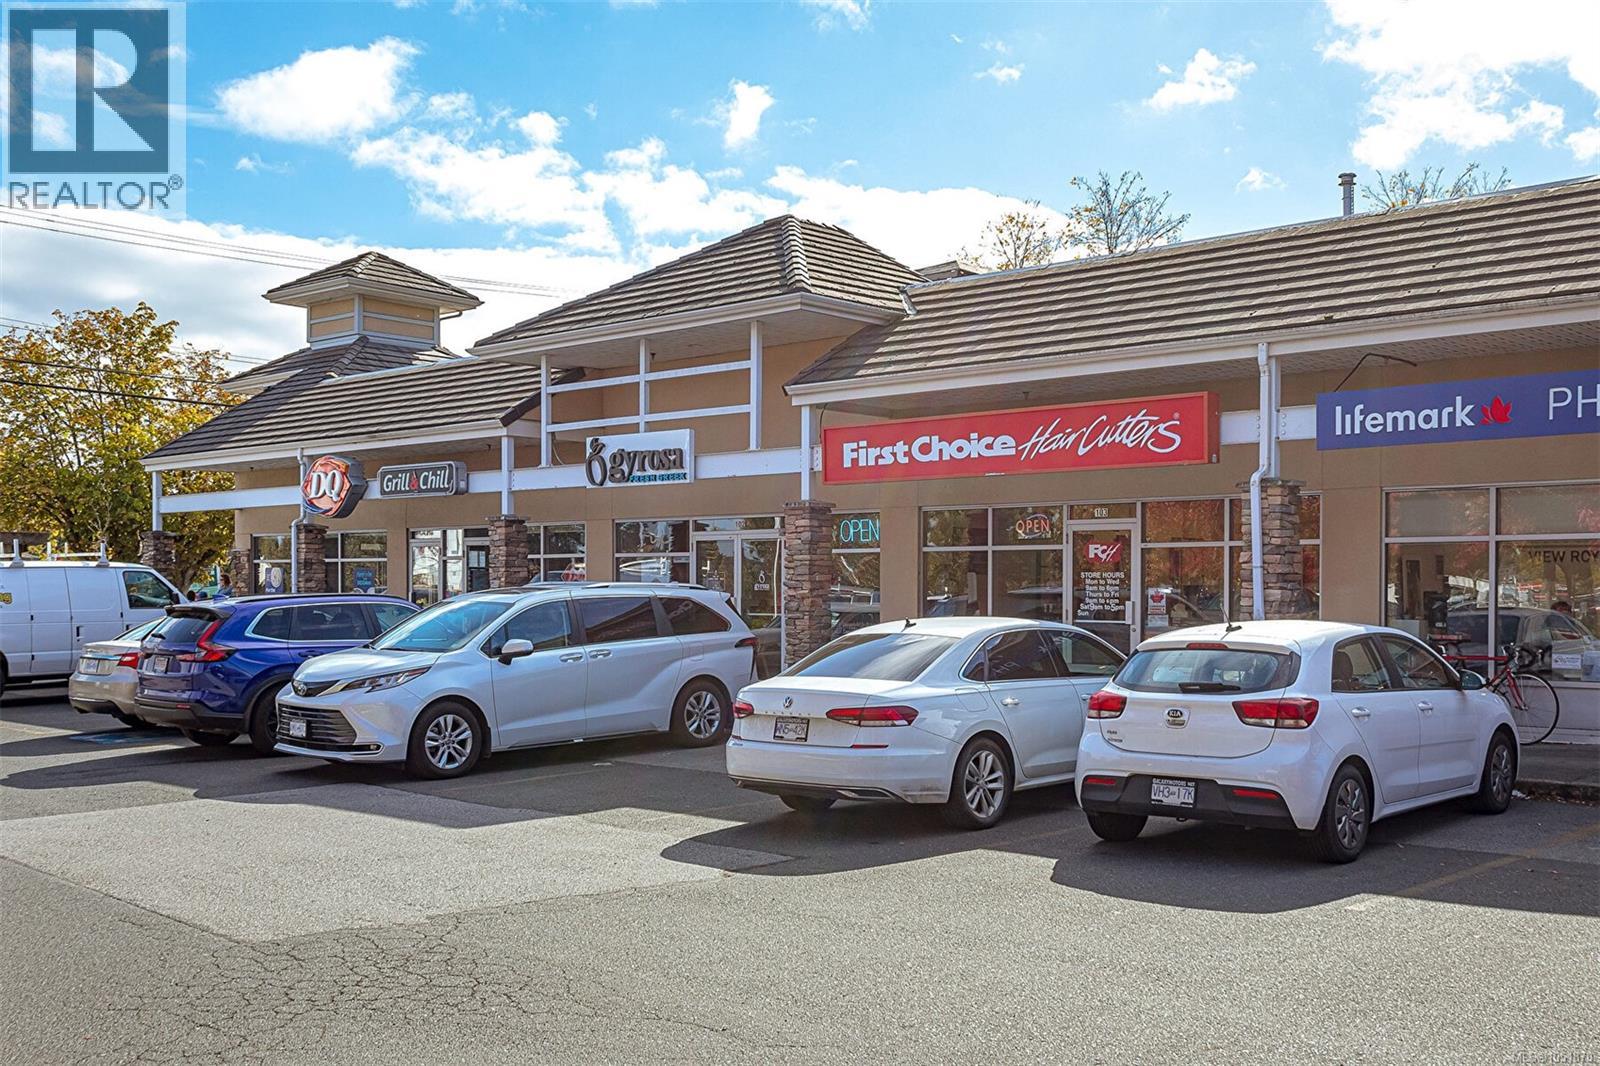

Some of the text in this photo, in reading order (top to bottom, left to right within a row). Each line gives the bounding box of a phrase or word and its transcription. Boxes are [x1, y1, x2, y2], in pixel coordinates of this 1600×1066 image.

[1335, 396, 1476, 436] lifemark
[843, 440, 909, 468] First
[911, 432, 1016, 463] Choice
[1018, 417, 1086, 461] Hair
[608, 448, 685, 483] gyrosa
[629, 472, 688, 483] FRESH GREEK
[309, 469, 344, 502] DQ
[383, 473, 410, 492] Grill
[420, 468, 450, 490] Chill
[1094, 508, 1109, 518] 103
[840, 518, 880, 543] OPEN
[1015, 519, 1051, 534] OPEN
[1528, 550, 1566, 563] VIEW
[1080, 571, 1125, 579] STORE HOURS
